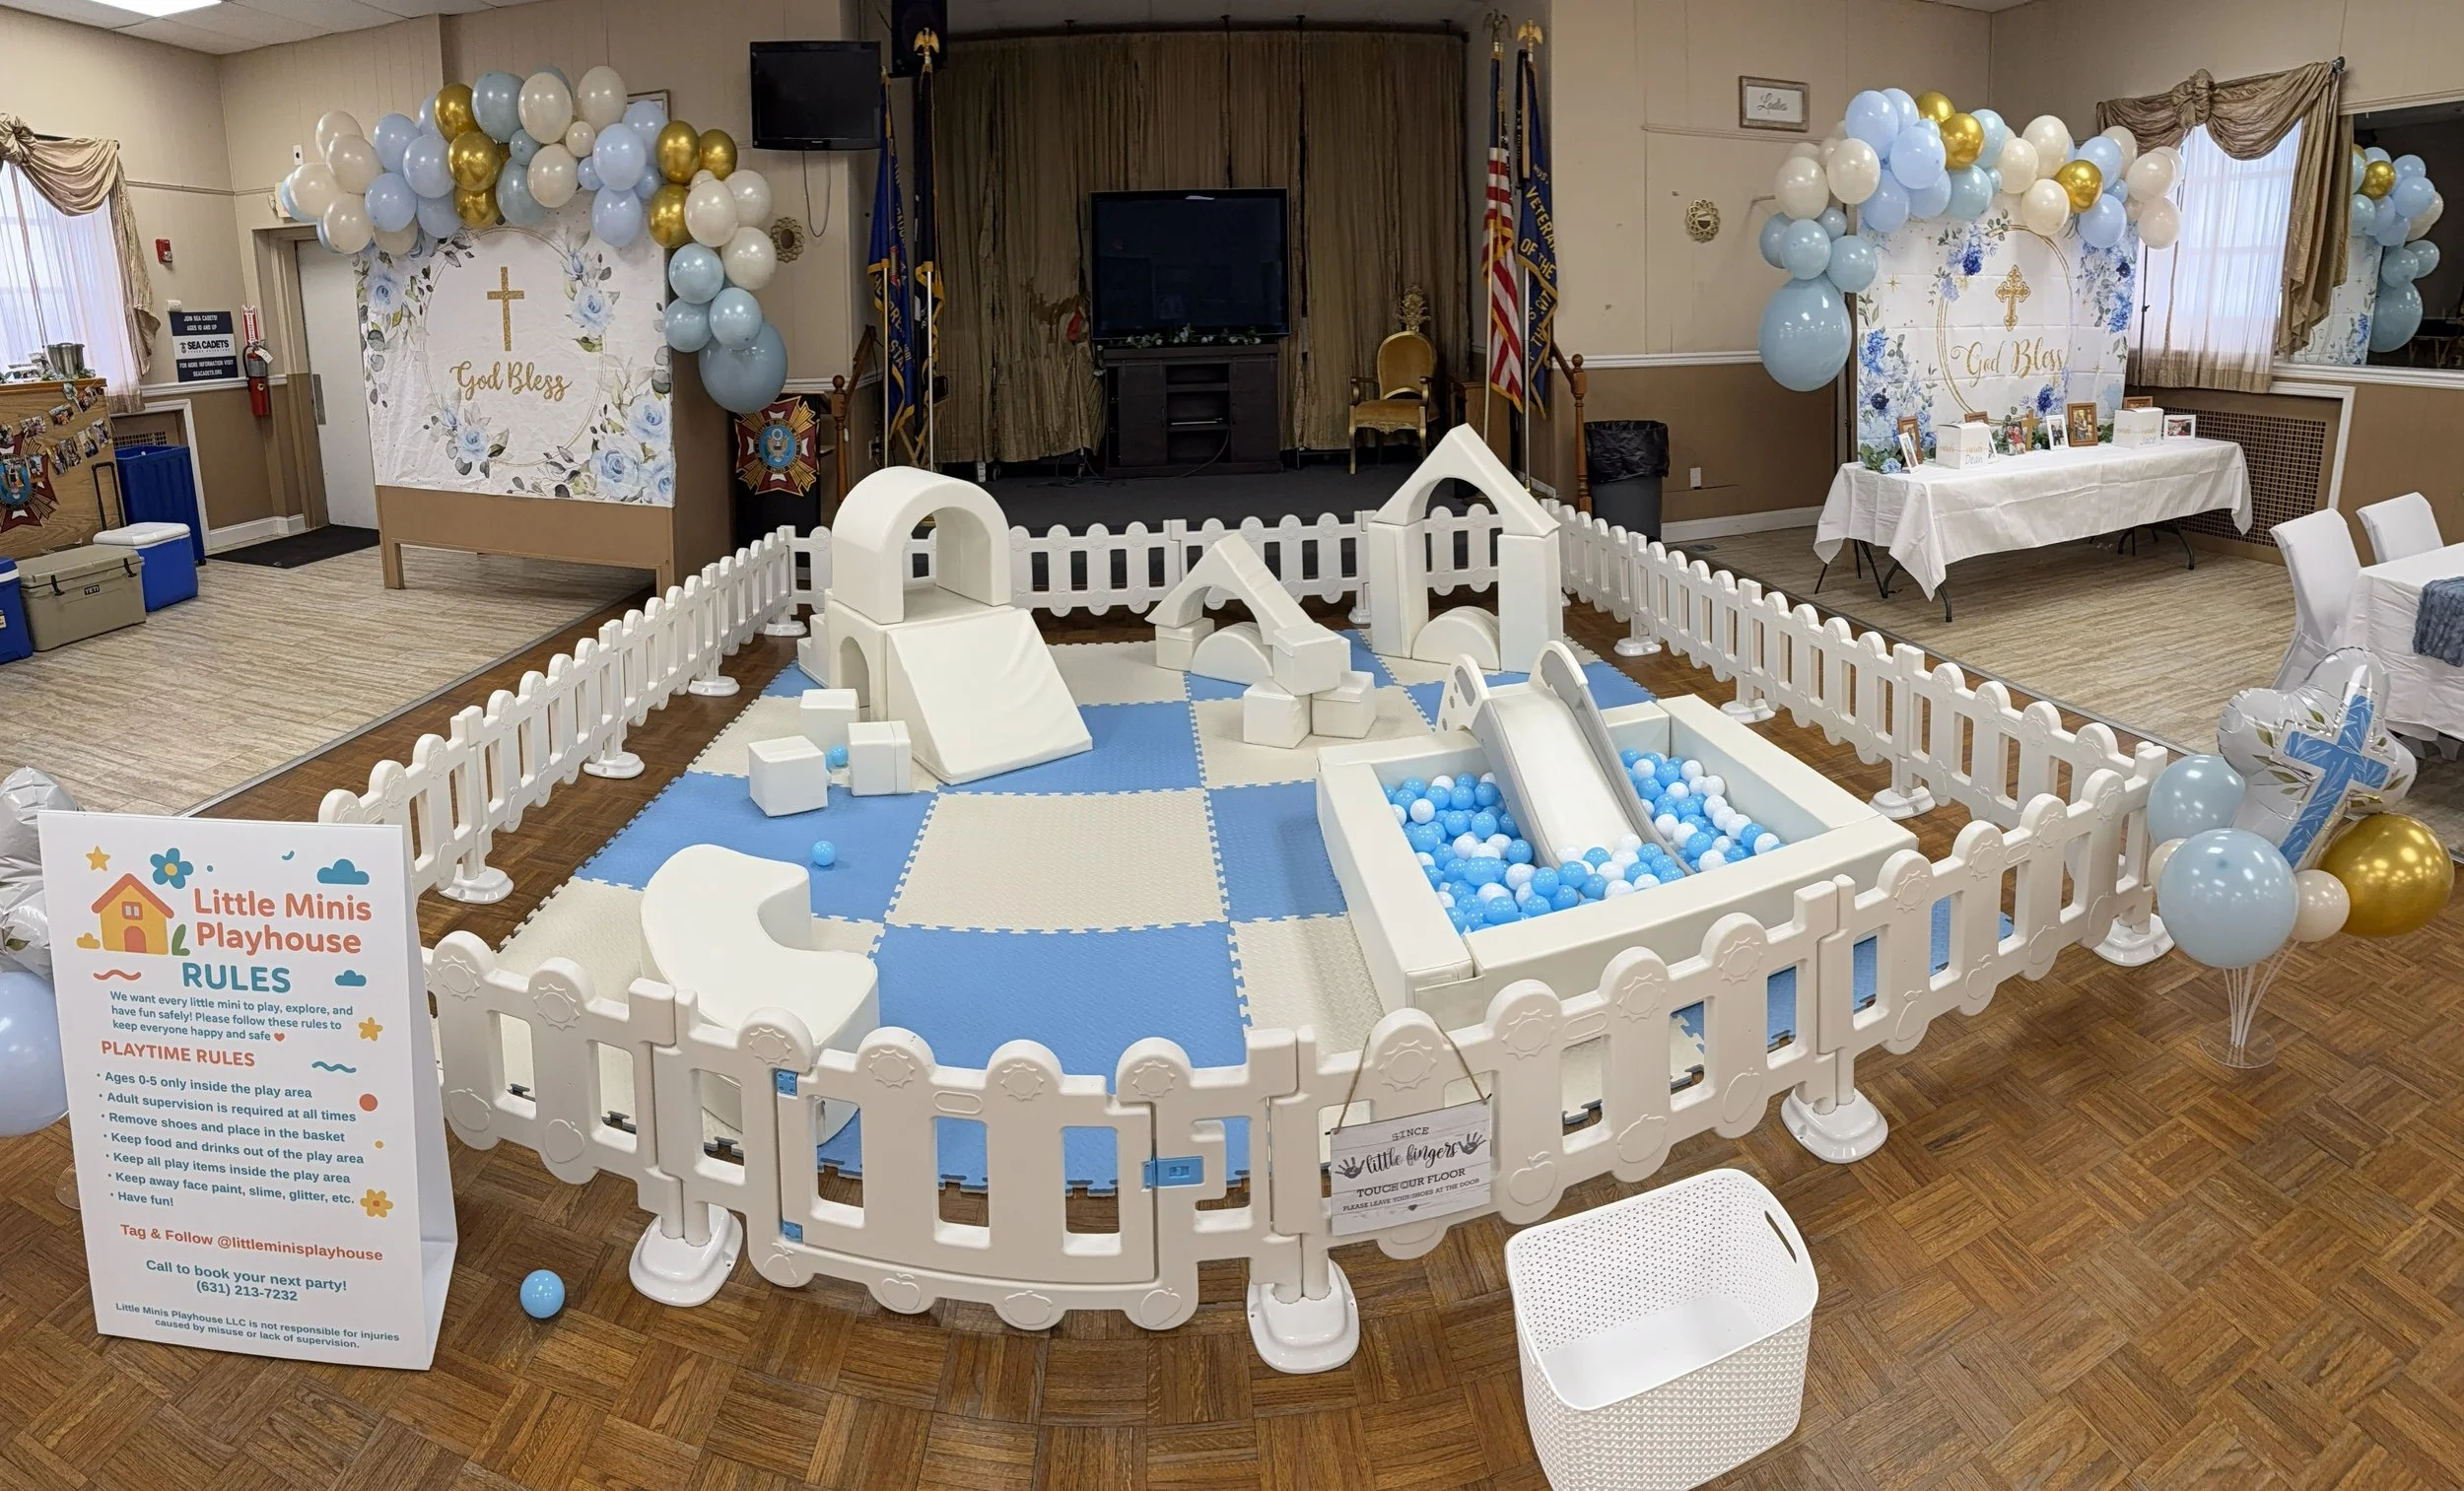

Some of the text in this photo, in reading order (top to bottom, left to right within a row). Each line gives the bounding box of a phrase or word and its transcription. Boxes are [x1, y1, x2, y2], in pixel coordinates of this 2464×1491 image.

[1520, 238, 1557, 279] OF THE
[187, 339, 230, 351] SEA CADETS
[192, 369, 223, 377] SEACADETS.ORG
[1951, 336, 2063, 388] God Bless
[449, 360, 573, 402] God Bless
[1964, 454, 1983, 465] Dean
[85, 585, 100, 594] YETI
[193, 888, 373, 921] Little Minis
[196, 921, 362, 956] Playhouse
[181, 962, 292, 993] RULES
[109, 990, 354, 1016] We want every little mini to play, explore, and
[111, 1005, 342, 1030] have fun safely! Please follow these rules to
[112, 1020, 271, 1041] keep everyone happy and safe
[101, 1040, 255, 1067] PLAYTIME RULES
[104, 1071, 312, 1099] Ages 0-5 only inside the play area
[106, 1092, 356, 1122] Adult supervision is required at all times
[108, 1112, 346, 1142] Remove shoes and place in the basket
[1392, 1126, 1429, 1141] SINCE
[110, 1132, 365, 1164] Keep food and drinks out of the play area
[1366, 1142, 1460, 1175] little fingers
[113, 1152, 351, 1184] Keep all play items inside the play area
[1356, 1168, 1467, 1198] TOUCH OUR FLOOR
[115, 1172, 355, 1204] Keep away face paint, slime, glitter, etc.
[117, 1191, 174, 1206] Have fun!
[1342, 1202, 1369, 1212] PLEASE
[1370, 1198, 1391, 1207] LEAVE
[1411, 1189, 1434, 1199] SHOES
[1445, 1184, 1459, 1192] THE
[1459, 1178, 1480, 1188] DOOR
[119, 1224, 383, 1261] Tag & Follow @littleminisplayhouse
[146, 1259, 347, 1293] Call to book your next party!
[196, 1280, 299, 1302] (631) 213-7232
[115, 1303, 400, 1341] Little Minis Playhouse LLC is not responsible for injuries
[155, 1318, 190, 1330] caused
[192, 1322, 205, 1333] by
[208, 1325, 244, 1337] misuse
[259, 1330, 281, 1341] lack
[283, 1333, 294, 1342] of
[296, 1336, 360, 1349] supervision.
